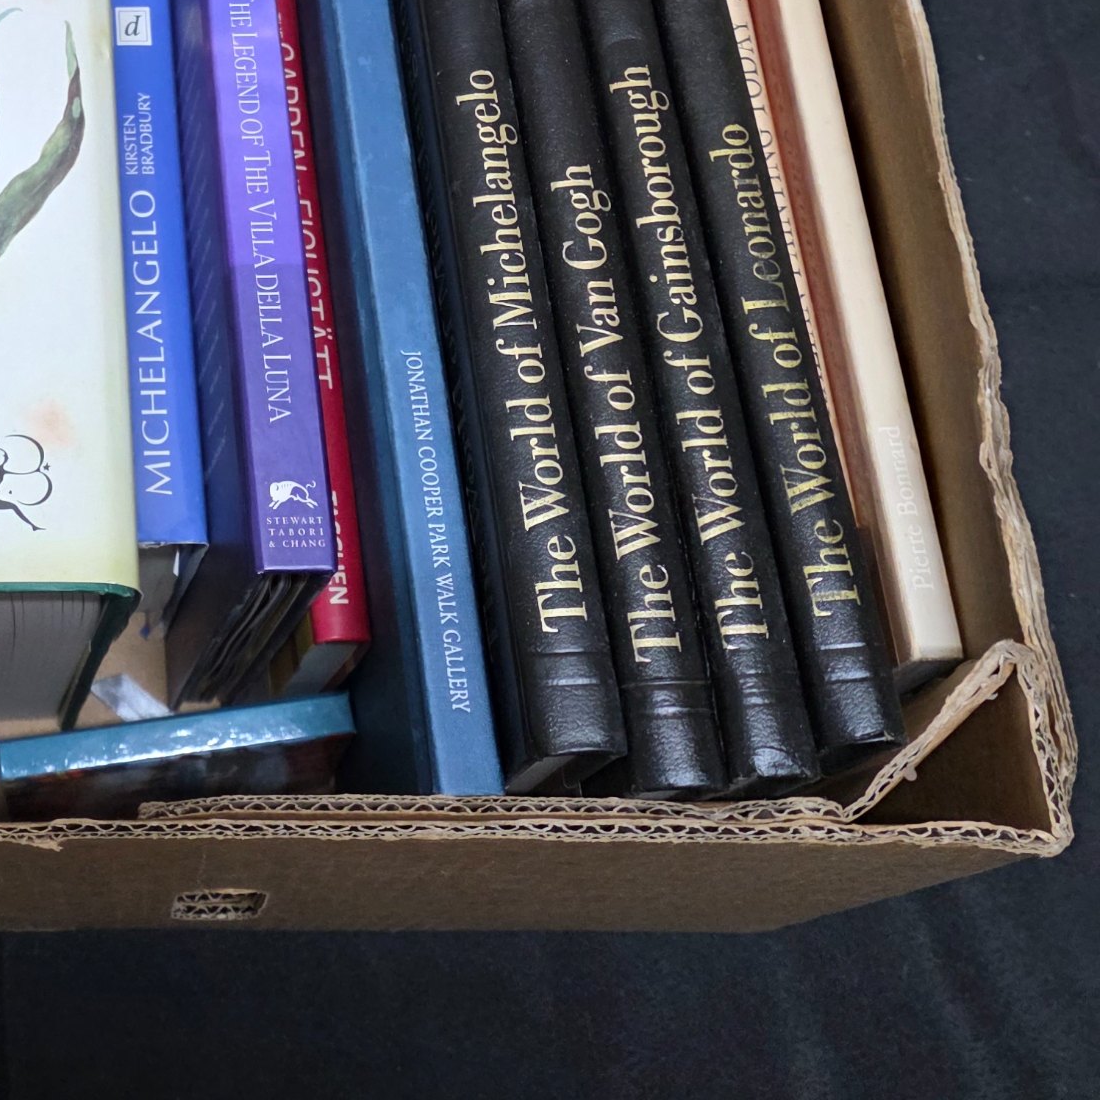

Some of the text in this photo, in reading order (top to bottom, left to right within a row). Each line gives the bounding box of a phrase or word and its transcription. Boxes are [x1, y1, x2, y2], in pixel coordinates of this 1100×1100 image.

[124, 14, 141, 37] d
[231, 31, 260, 113] LEGEND
[123, 115, 138, 175] KIRSTEN
[137, 92, 155, 175] BRADBURY
[240, 118, 265, 146] OF
[243, 150, 271, 195] THE
[247, 202, 277, 274] VILLA
[709, 123, 791, 313] Leonardo
[129, 190, 173, 495] MICHELANGELO
[255, 274, 284, 347] DELLA
[748, 320, 802, 370] of
[262, 353, 292, 423] LUNA
[456, 67, 590, 634] The World of Michelangelo
[610, 64, 768, 652] The World of Gainsborough
[551, 162, 683, 664] The World of Van Gogh
[764, 377, 835, 515] World
[266, 516, 323, 525] STEWART
[268, 528, 323, 536] TABORI
[269, 539, 326, 548] & CHANG
[401, 351, 471, 713] JONATHAN COOPER PARK WALK GALLERY
[877, 424, 935, 591] Pierre Bonnard
[802, 517, 861, 619] The
